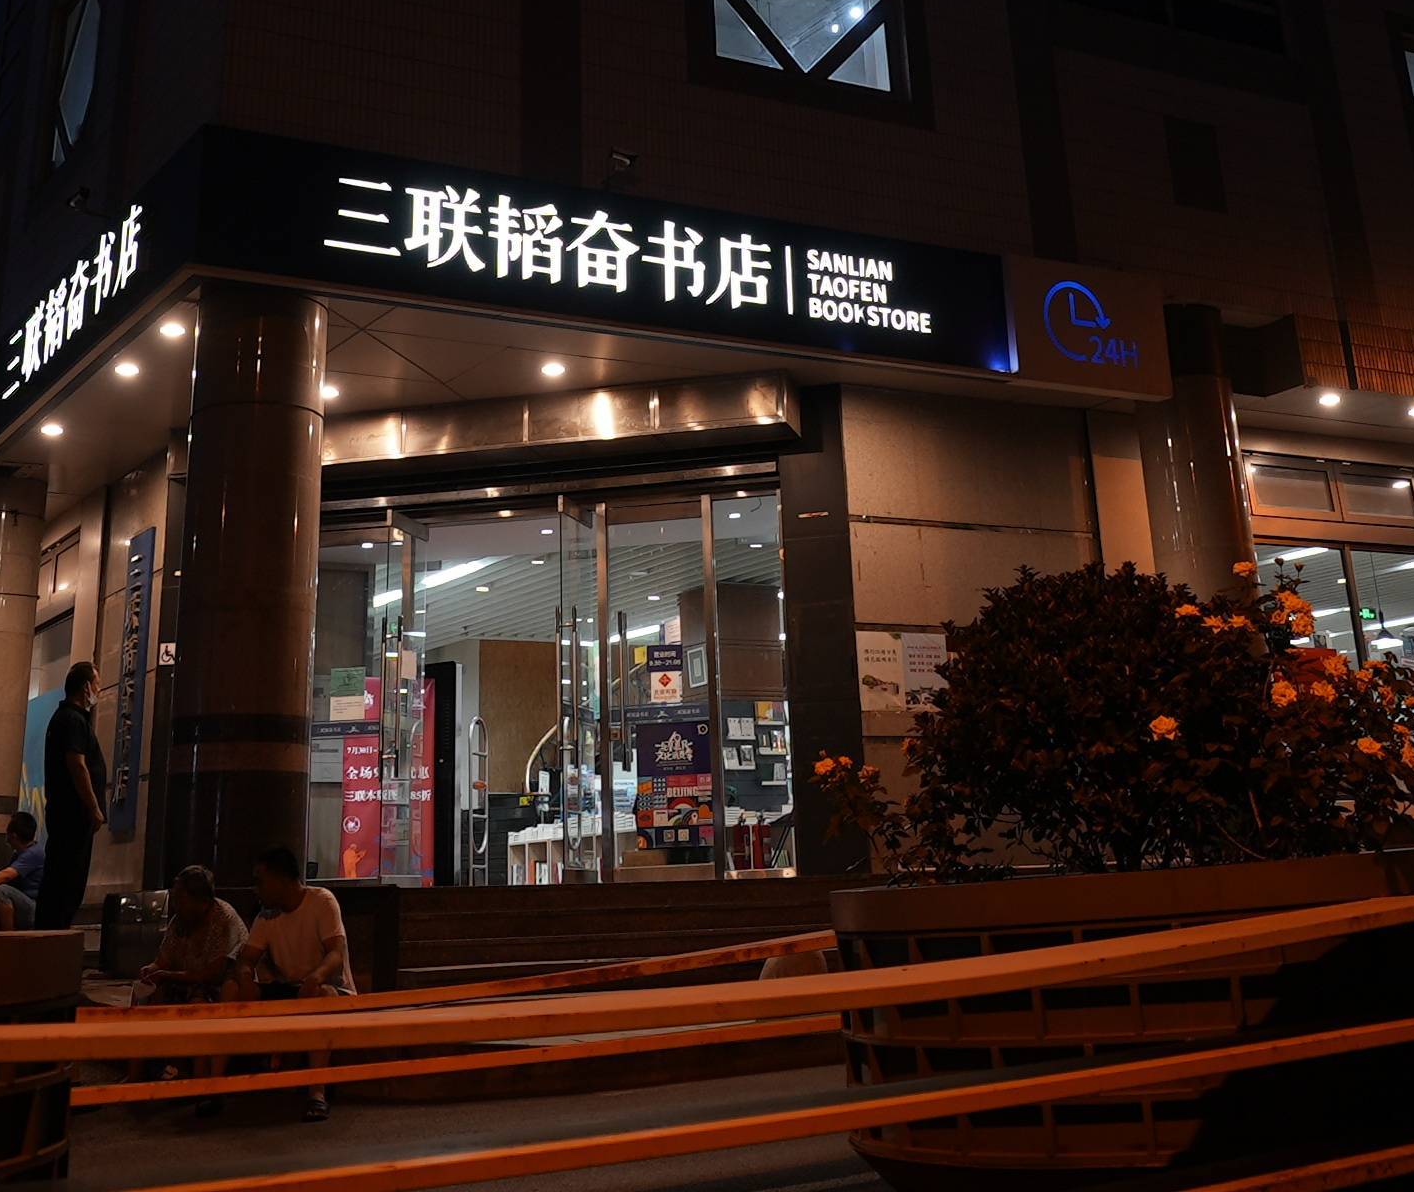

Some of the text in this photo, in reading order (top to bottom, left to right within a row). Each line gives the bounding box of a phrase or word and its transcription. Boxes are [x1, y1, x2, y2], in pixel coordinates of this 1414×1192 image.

[323, 177, 772, 309] 三联韬奋书店
[806, 248, 893, 282] SANLIAN
[1, 204, 143, 400] 三联韬奋书店
[806, 272, 888, 304] TAOFEN
[808, 297, 932, 334] BOOKSTORE
[1089, 335, 1140, 369] 24H
